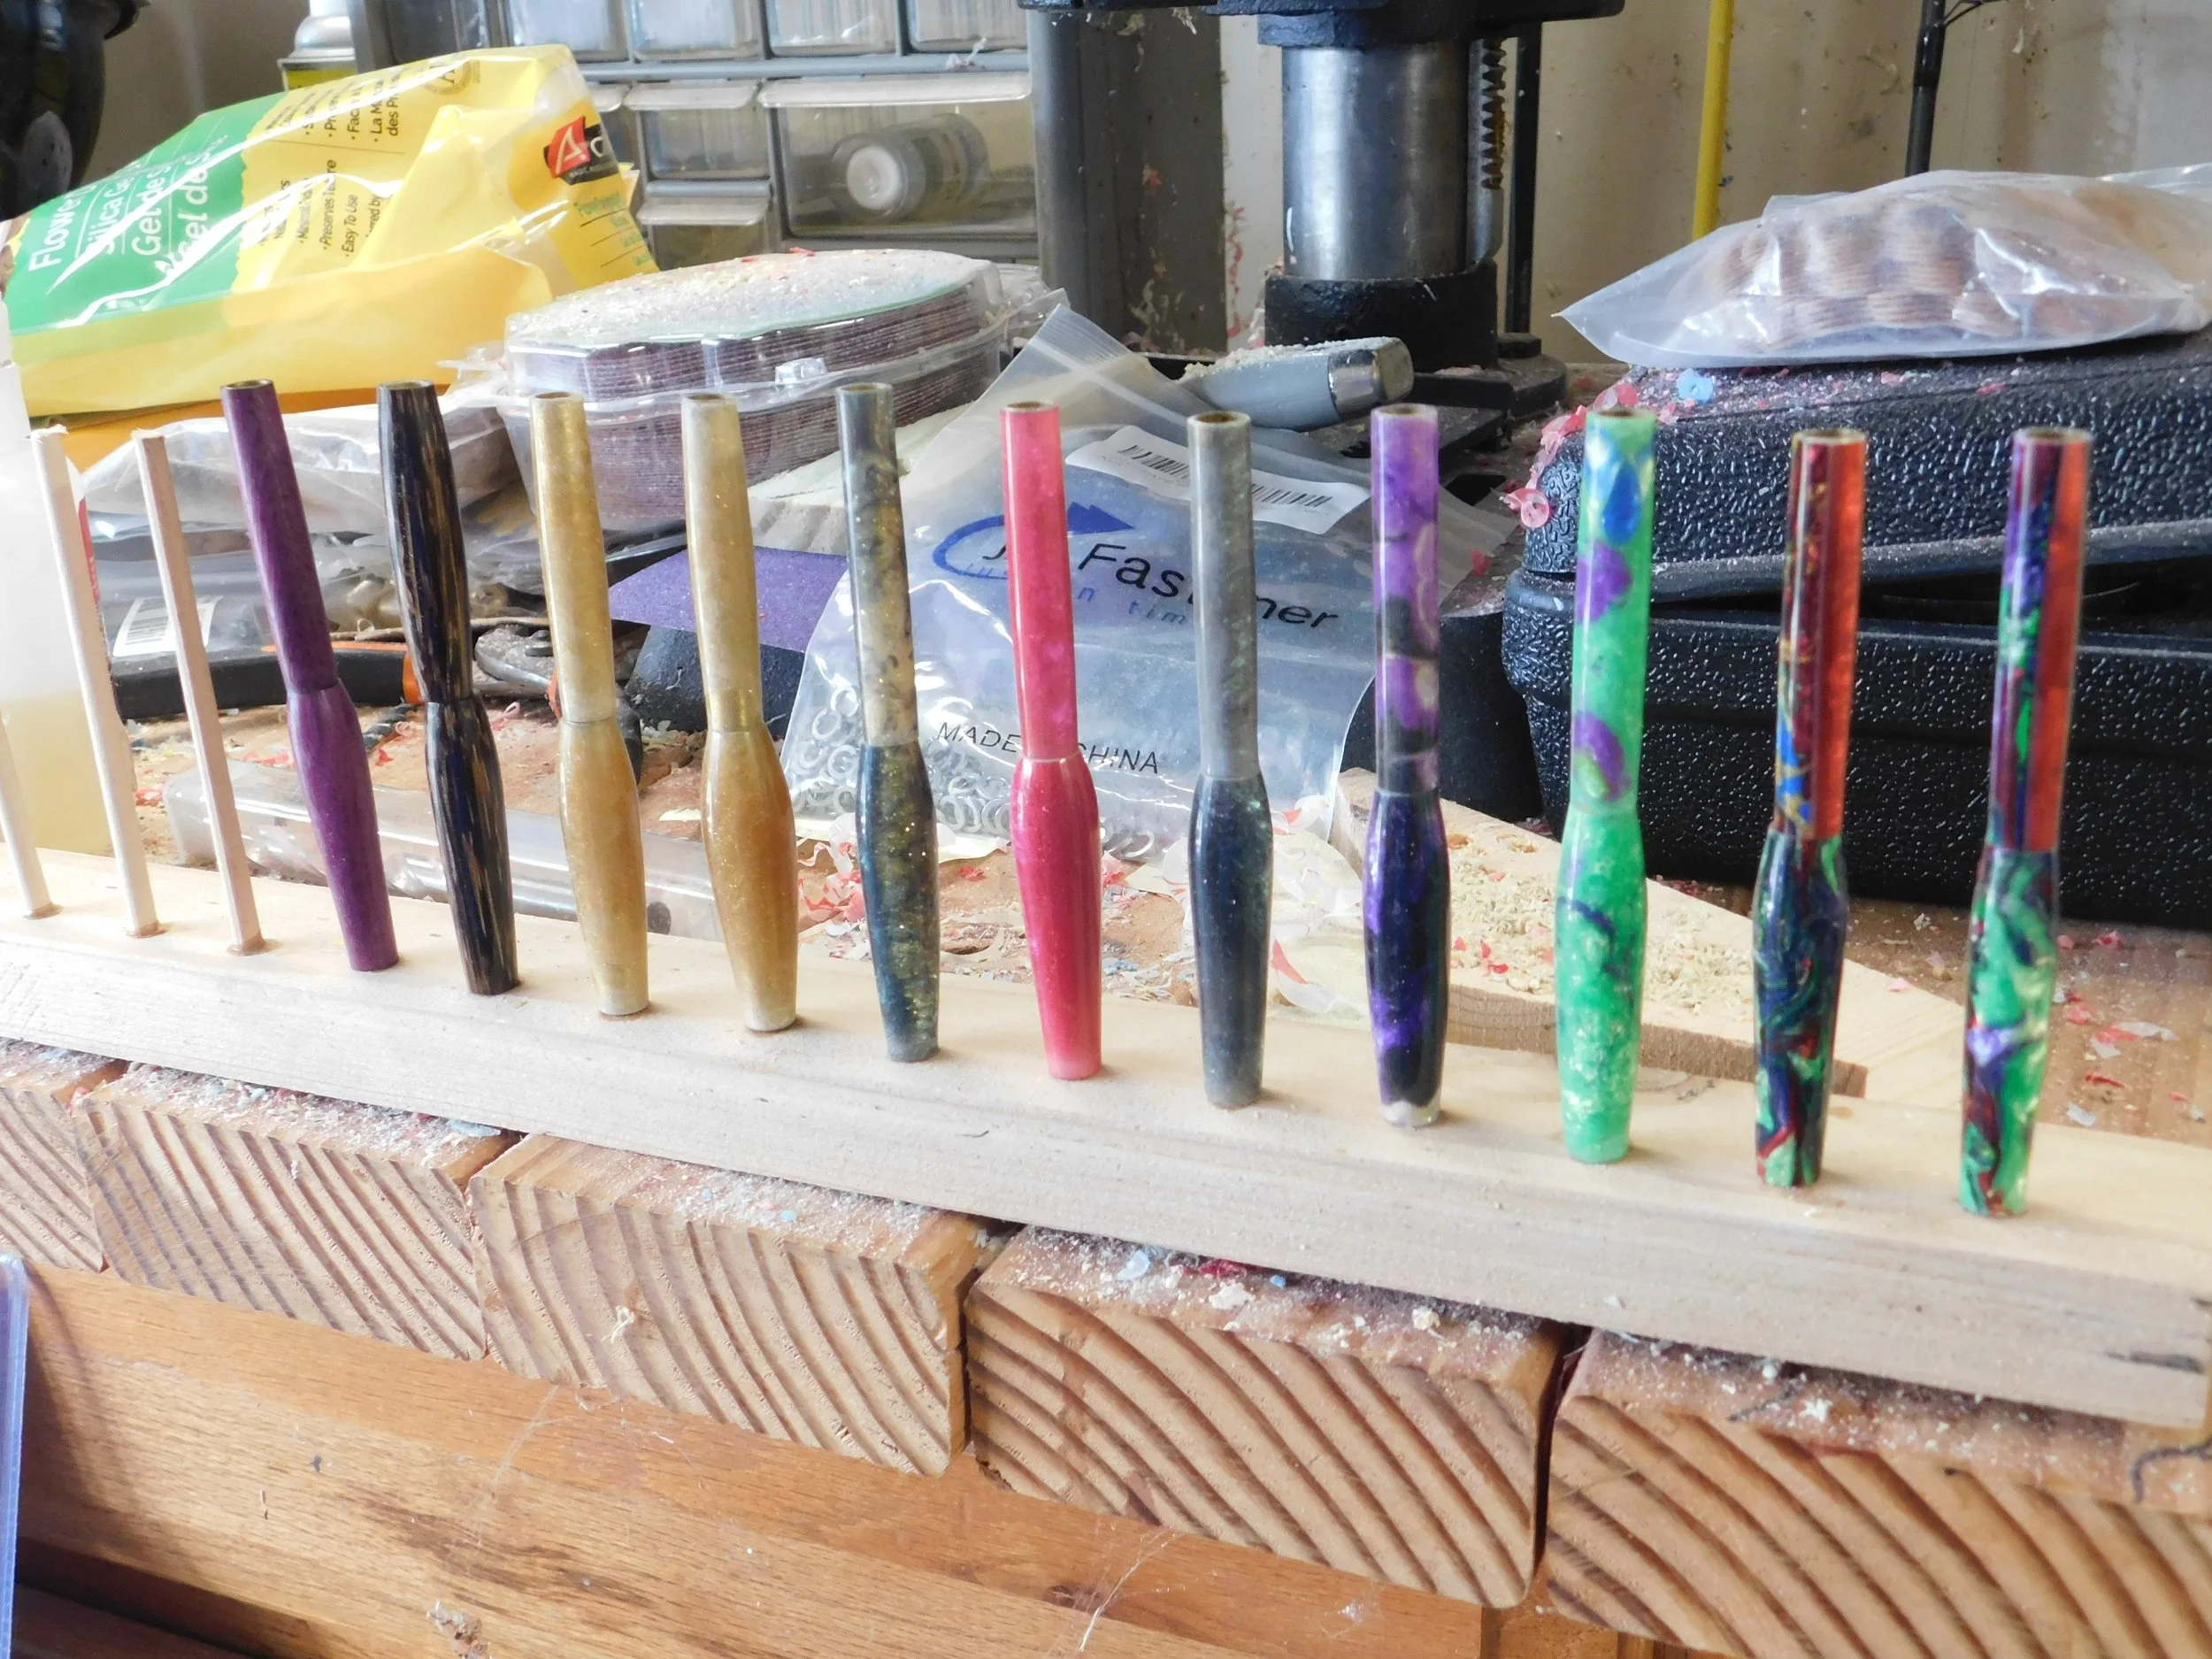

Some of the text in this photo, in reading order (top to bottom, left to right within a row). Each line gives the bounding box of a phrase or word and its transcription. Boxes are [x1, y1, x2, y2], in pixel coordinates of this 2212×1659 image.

[386, 111, 399, 136] des
[131, 206, 163, 256] Gel
[319, 198, 335, 247] Preserves
[343, 214, 357, 227] To
[342, 227, 359, 253] Easy
[1077, 542, 1339, 628] Fasner
[1127, 600, 1187, 626] tim
[937, 721, 1159, 775] MADE HINA
